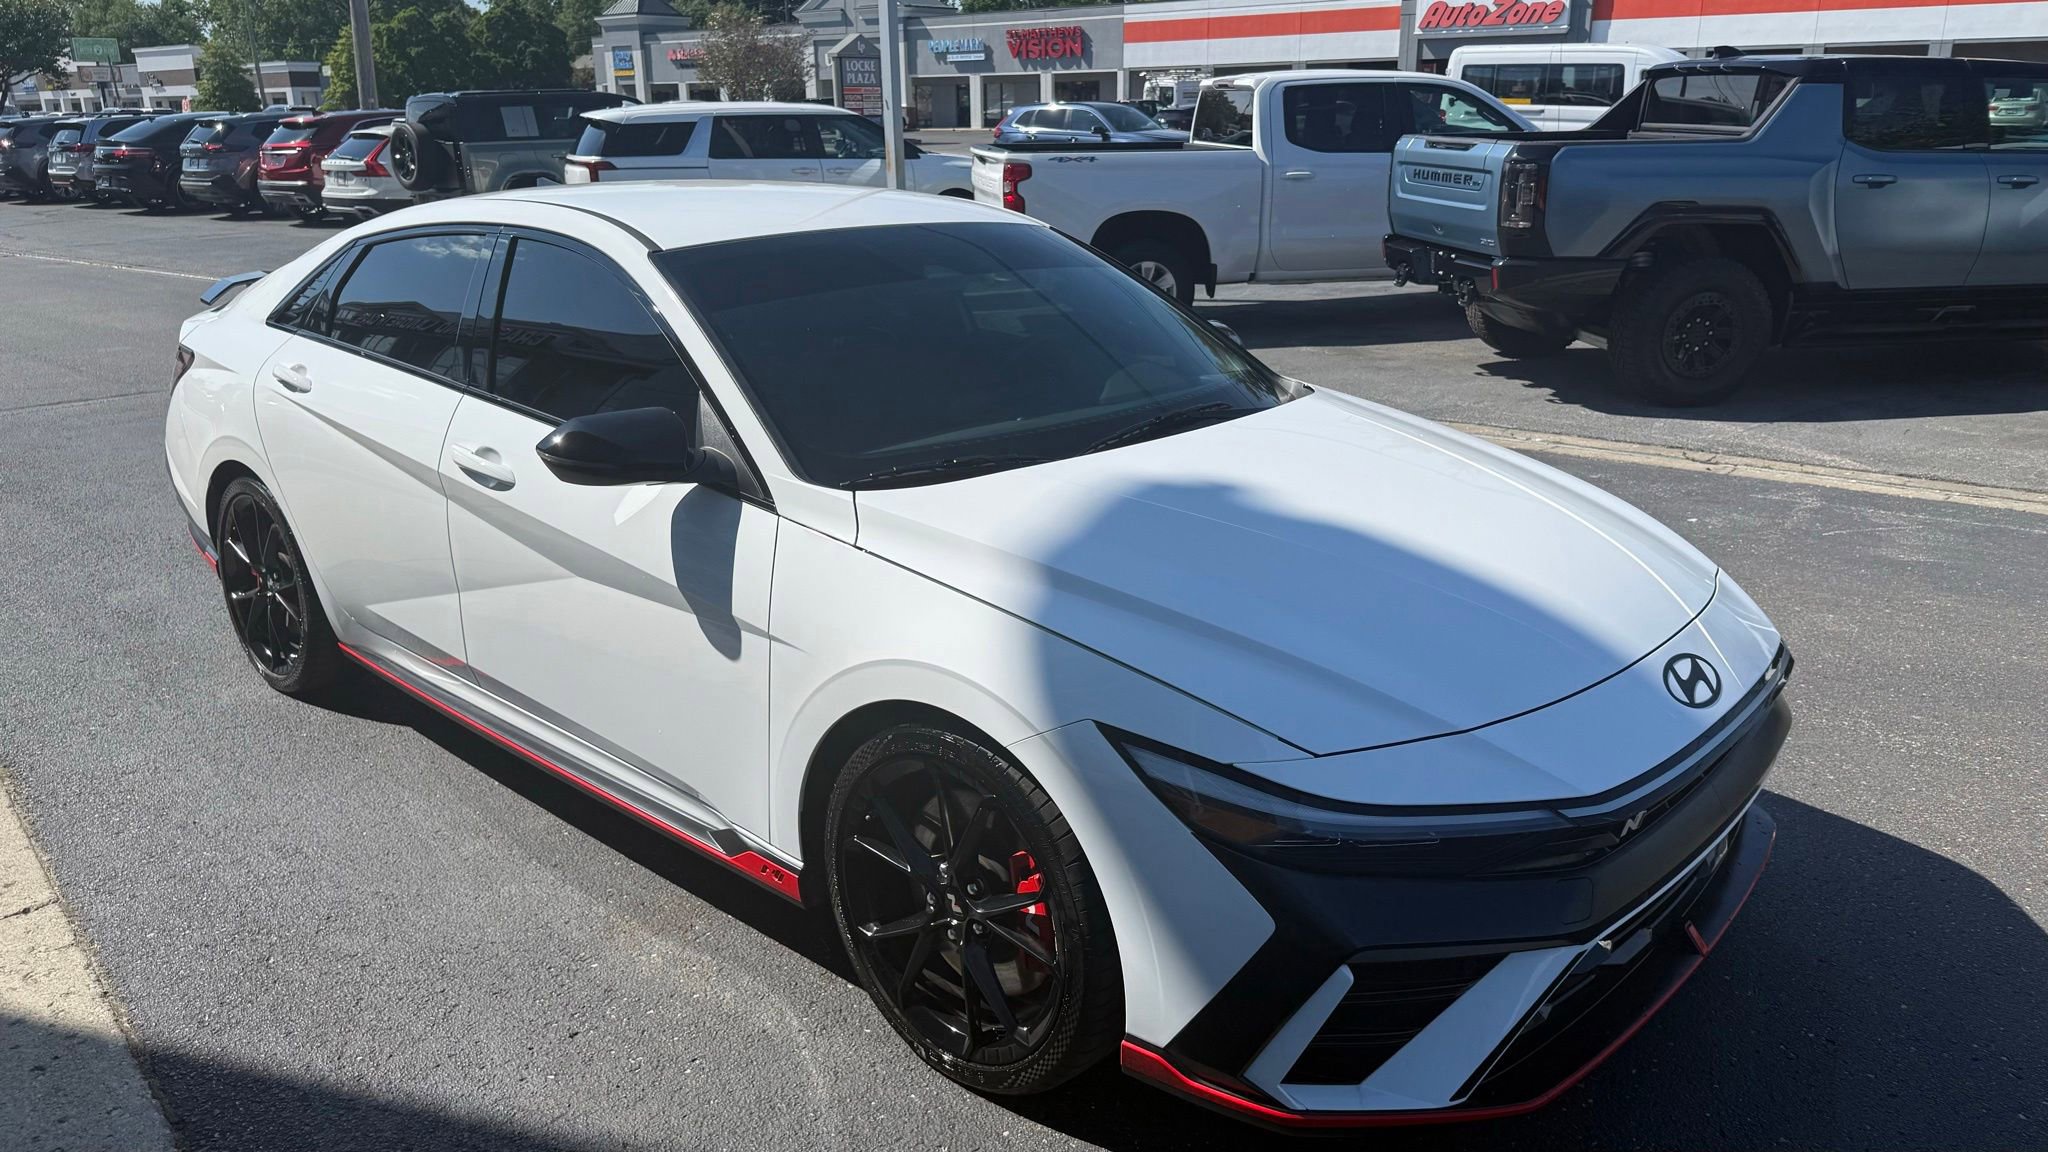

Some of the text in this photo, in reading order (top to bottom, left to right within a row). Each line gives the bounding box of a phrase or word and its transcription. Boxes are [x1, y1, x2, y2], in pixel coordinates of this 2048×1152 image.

[1418, 0, 1565, 29] AutoZone
[1022, 26, 1081, 38] MATTHEWS
[1007, 38, 1083, 59] VISION
[846, 60, 876, 72] LOCKE
[847, 73, 876, 84] PLAZA
[1413, 168, 1473, 186] HUMMER
[1620, 810, 1648, 837] N
